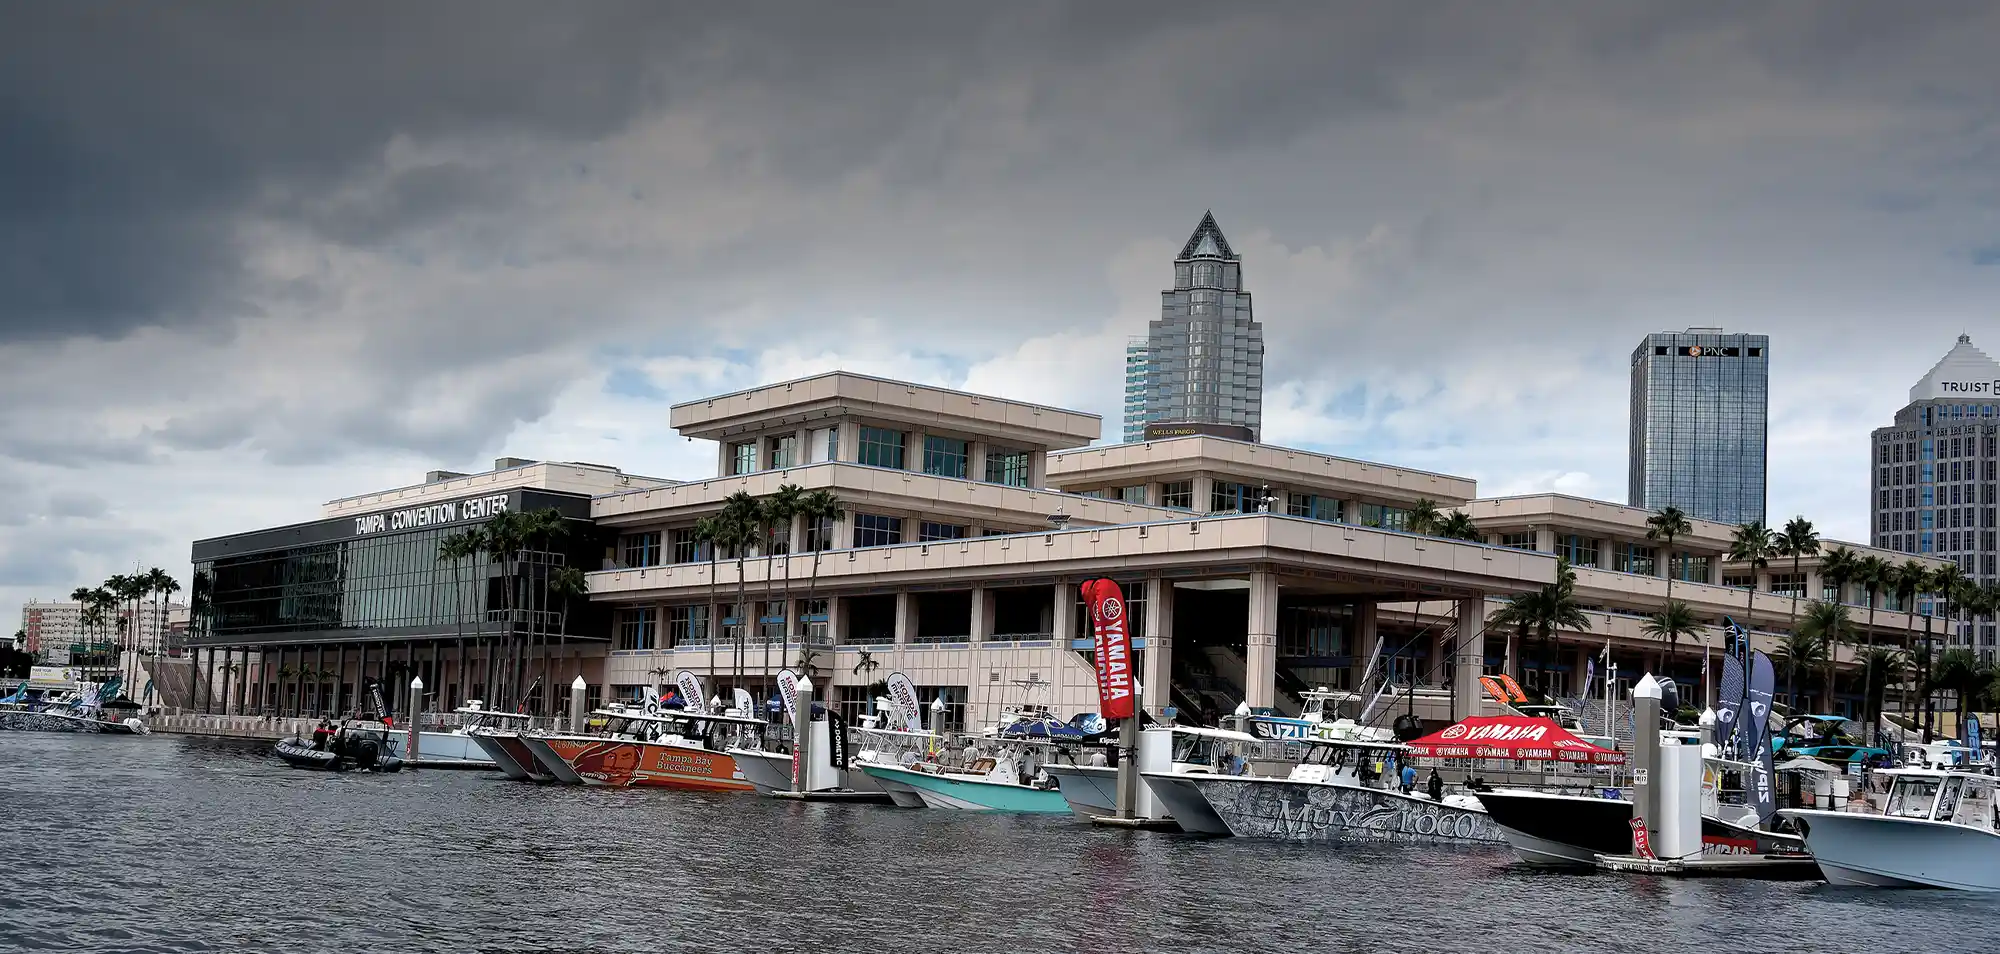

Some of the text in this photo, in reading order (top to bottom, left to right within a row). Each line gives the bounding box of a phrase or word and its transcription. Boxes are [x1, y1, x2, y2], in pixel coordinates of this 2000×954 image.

[1703, 347, 1729, 356] PNC
[1941, 382, 1990, 392] TRUIST
[355, 494, 509, 534] TAMPA CONVENTION CENTER
[1105, 619, 1129, 700] YAMAHA
[680, 680, 697, 707] MARIN
[785, 676, 798, 700] HON
[896, 680, 918, 718] HONDA
[1464, 723, 1547, 741] YAMAHA
[1443, 747, 1469, 756] YAMAHA
[1483, 748, 1509, 758] YAMAHA
[1525, 748, 1552, 758] YAMAHA
[1565, 750, 1588, 761] YAMAHA
[1600, 752, 1623, 762] YAMAHA
[659, 752, 713, 766] Tampa Bay
[656, 761, 713, 774] Buccaneers
[1271, 799, 1477, 839] MUY LOCO
[1632, 820, 1644, 829] NO
